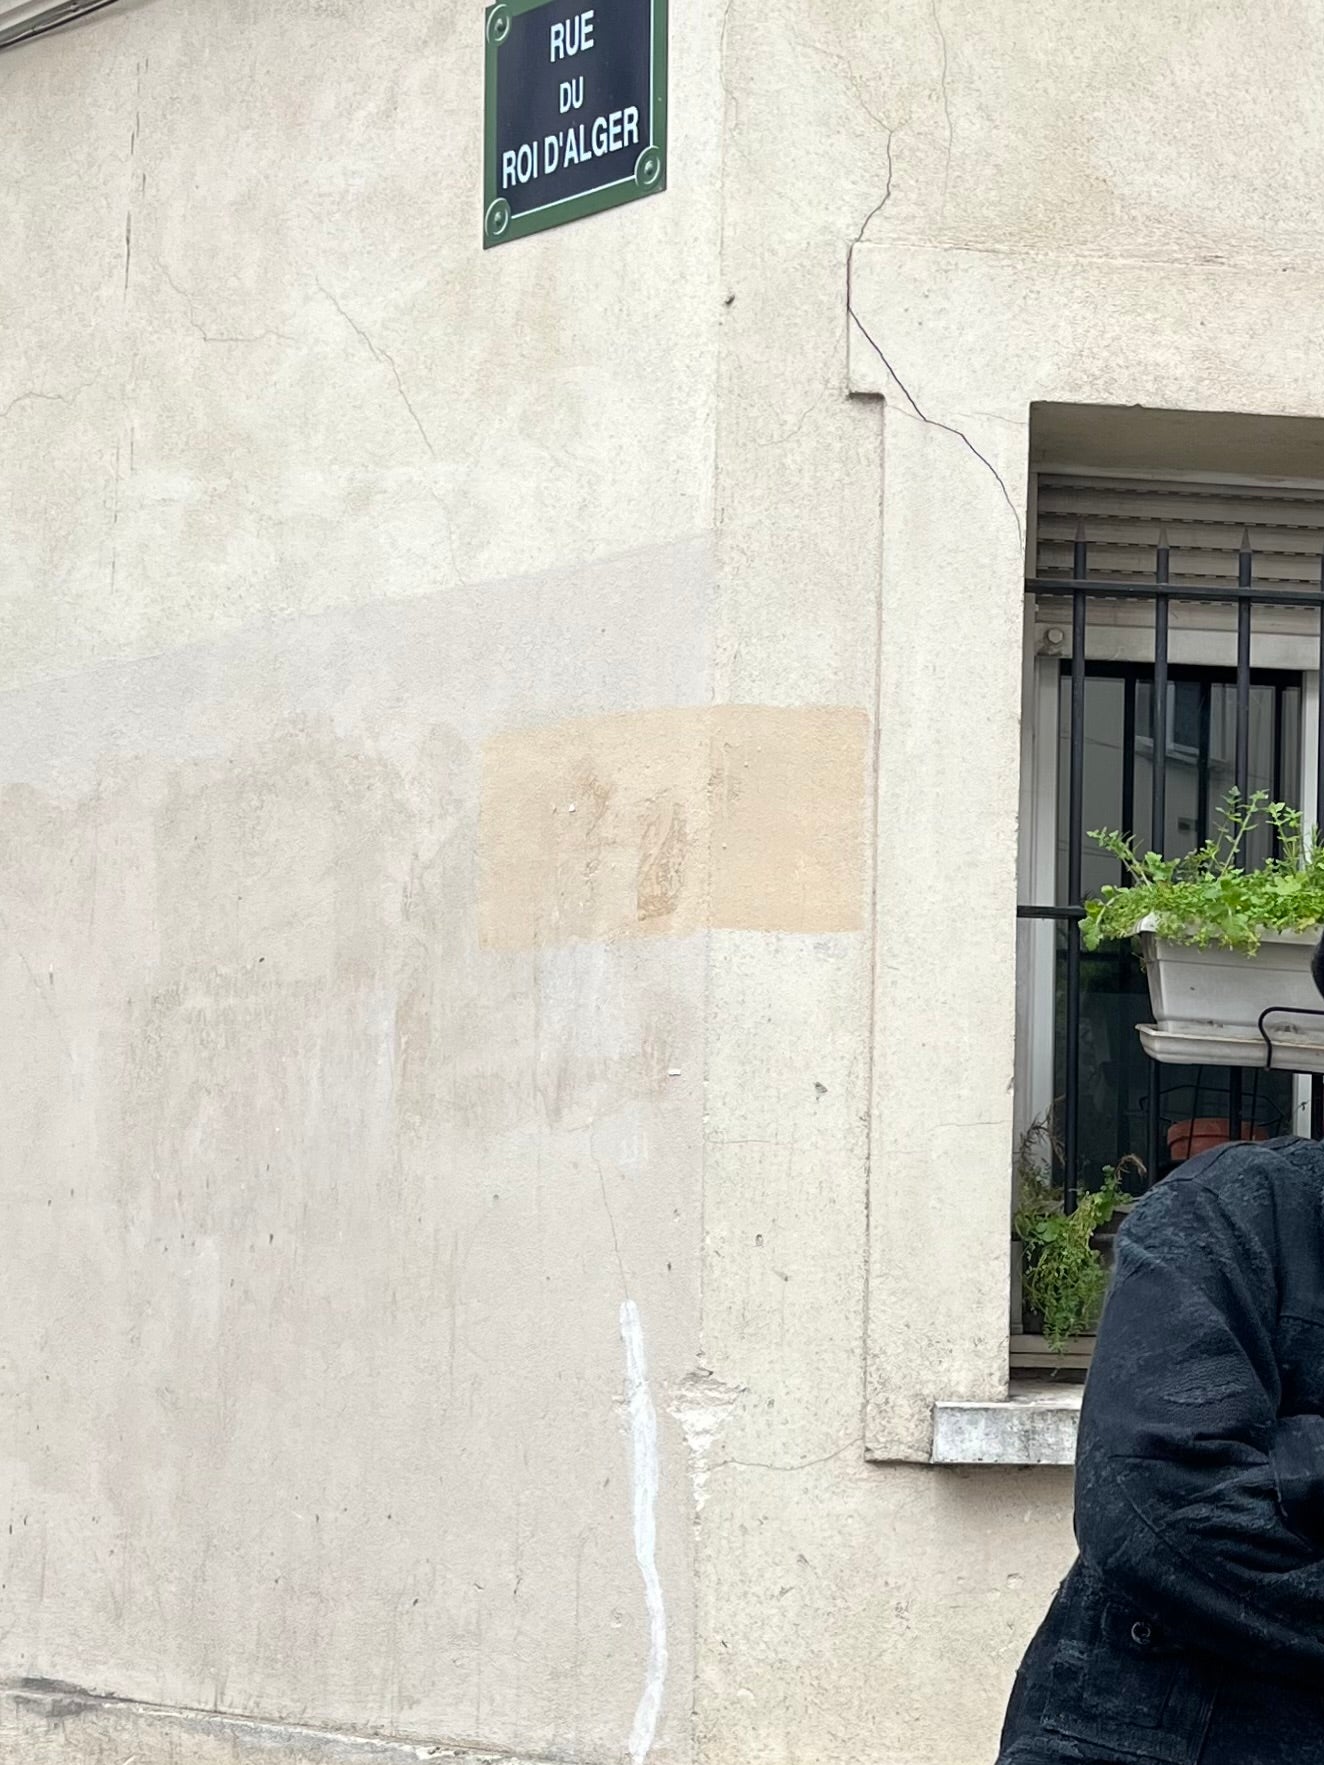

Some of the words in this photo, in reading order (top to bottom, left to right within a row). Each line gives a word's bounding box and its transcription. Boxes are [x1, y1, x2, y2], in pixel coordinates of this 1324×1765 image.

[550, 9, 594, 63] RUE
[559, 76, 583, 114] DU
[502, 141, 538, 189] ROI
[544, 106, 639, 174] D'ALGER
